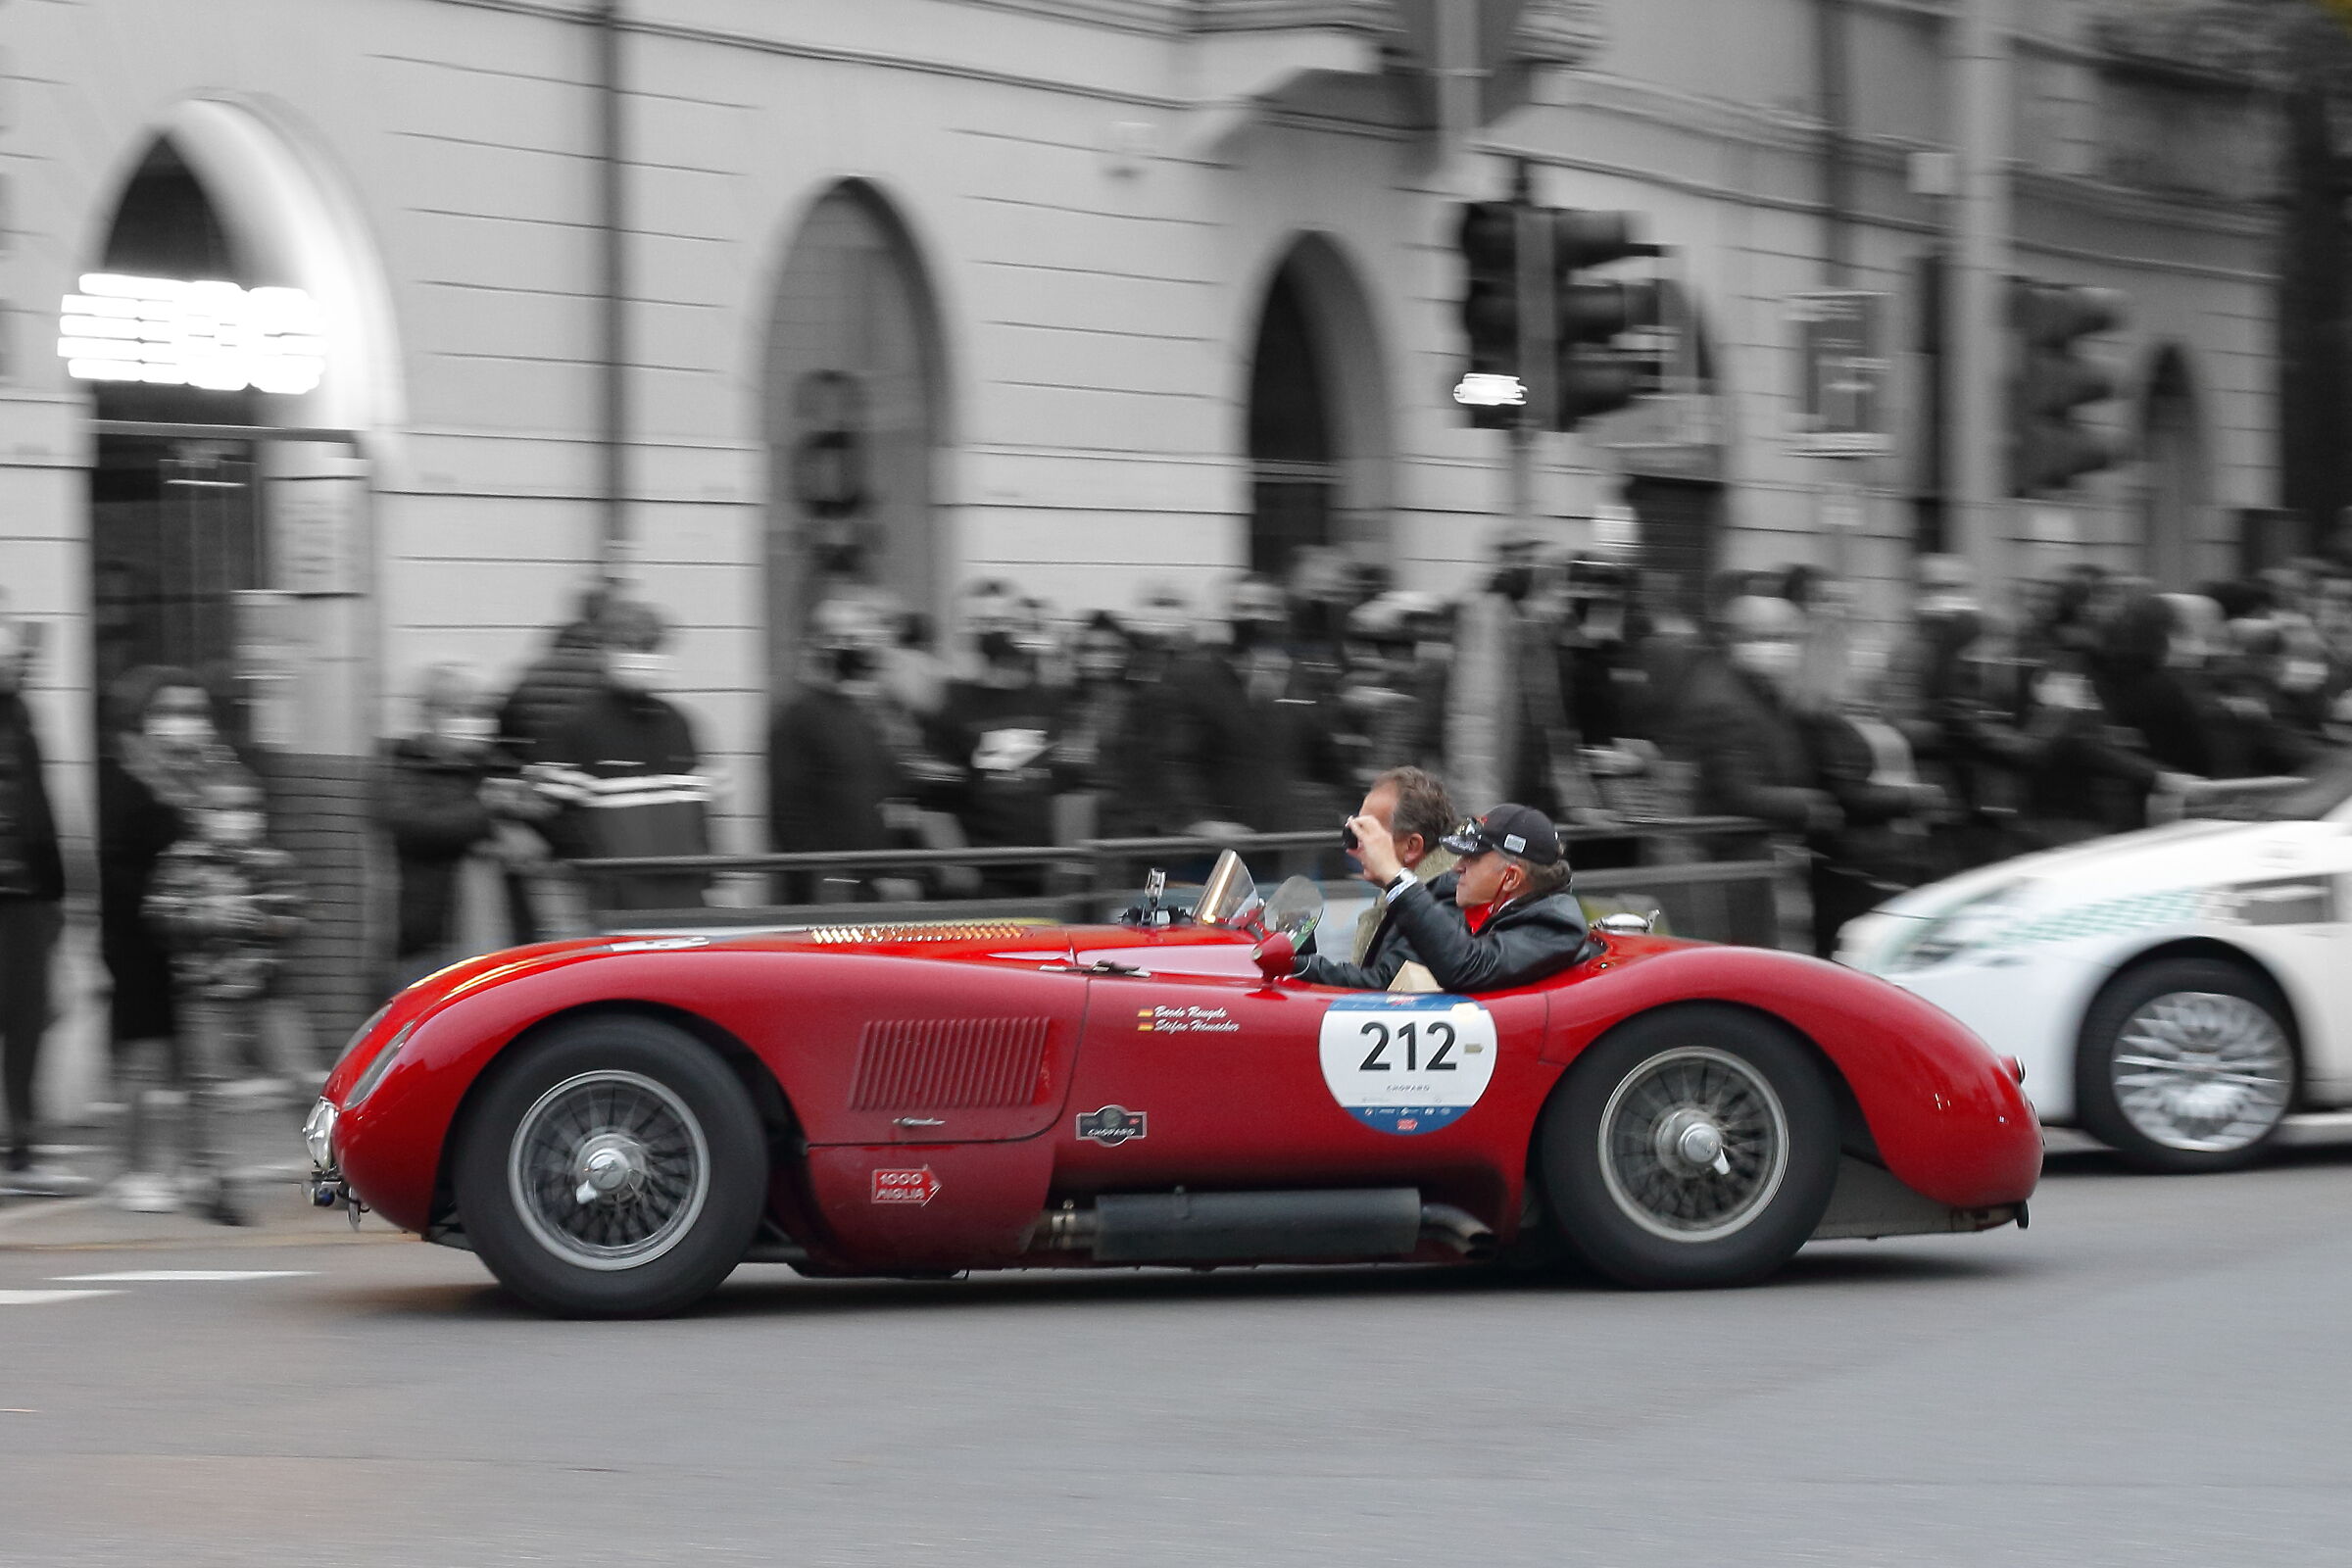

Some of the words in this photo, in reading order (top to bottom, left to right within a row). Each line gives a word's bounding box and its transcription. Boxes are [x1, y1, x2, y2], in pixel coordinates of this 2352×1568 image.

[1154, 1019, 1189, 1035] Stefan
[1359, 1022, 1457, 1071] 212
[1087, 1128, 1136, 1137] CHOPARD
[879, 1172, 923, 1185] 1000
[876, 1187, 925, 1200] MIGLIA
